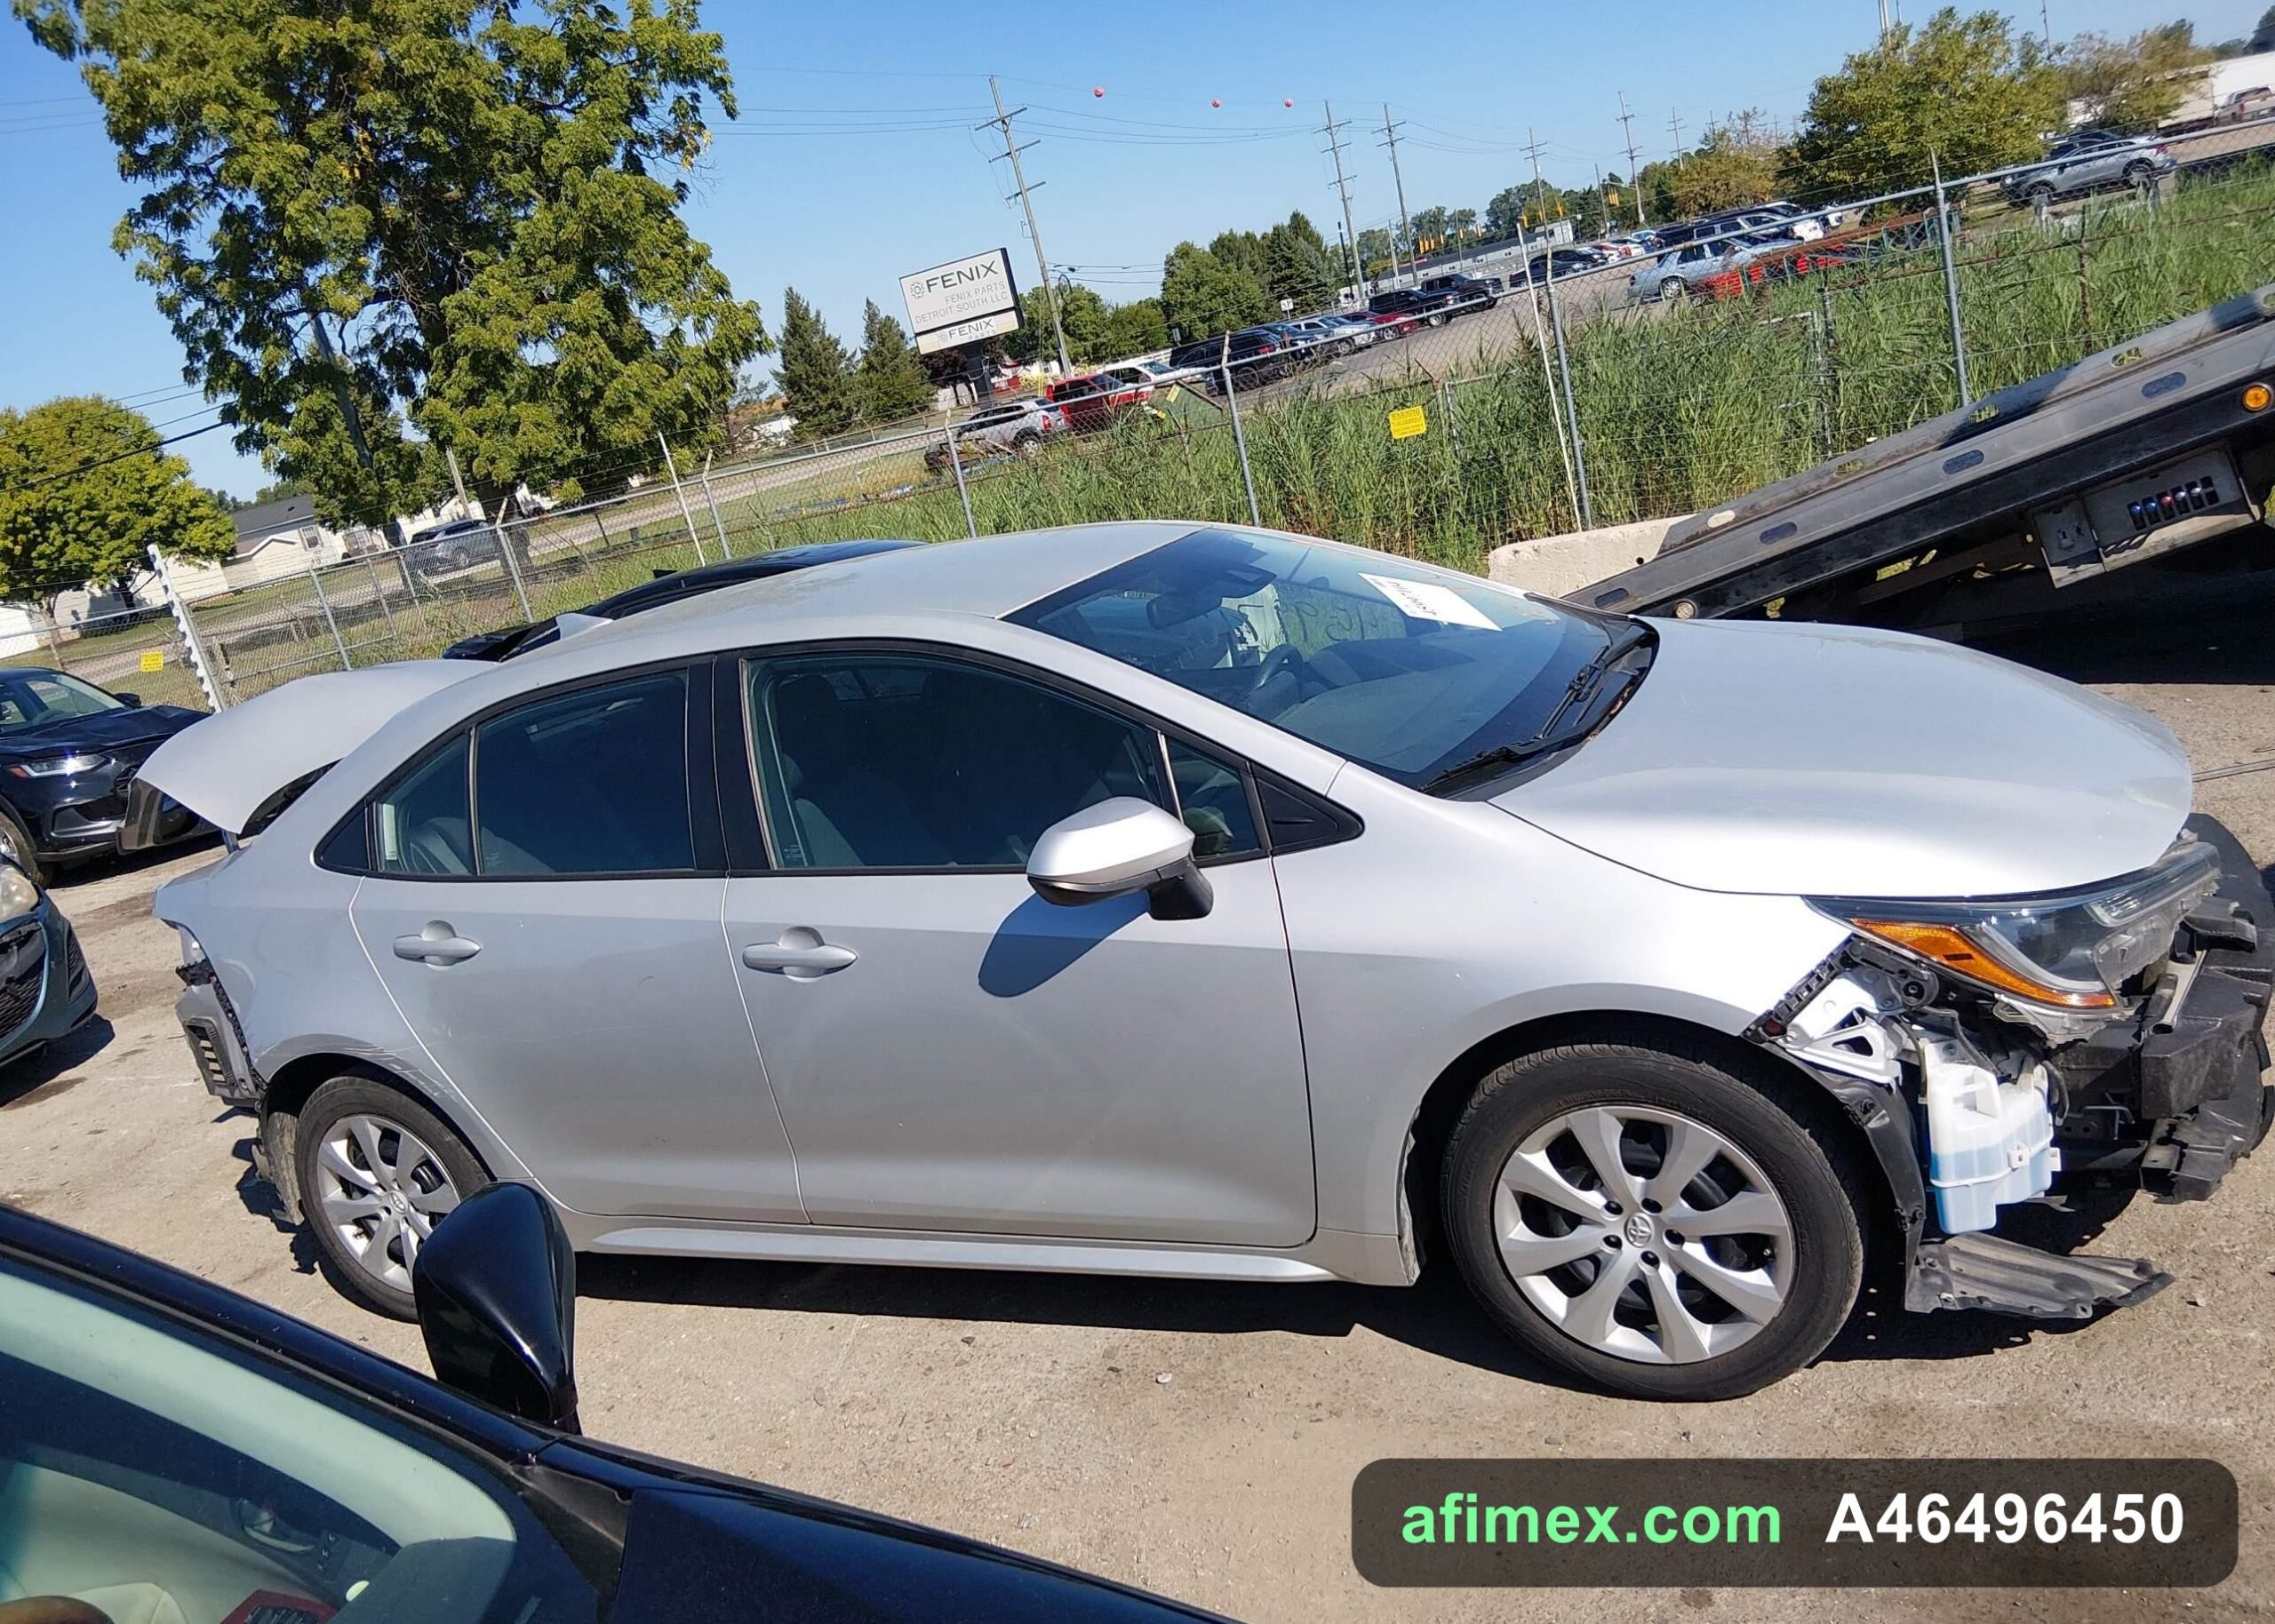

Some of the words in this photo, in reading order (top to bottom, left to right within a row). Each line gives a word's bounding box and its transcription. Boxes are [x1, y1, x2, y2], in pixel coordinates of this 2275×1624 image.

[925, 260, 999, 294] FENIX
[945, 289, 973, 306] FENIX
[974, 281, 1006, 298] PARTS
[915, 306, 954, 324] DETROIT
[955, 296, 988, 313] SOUTH
[990, 291, 1008, 303] LLC
[947, 318, 994, 340] FENIX
[968, 330, 997, 340] PARTS
